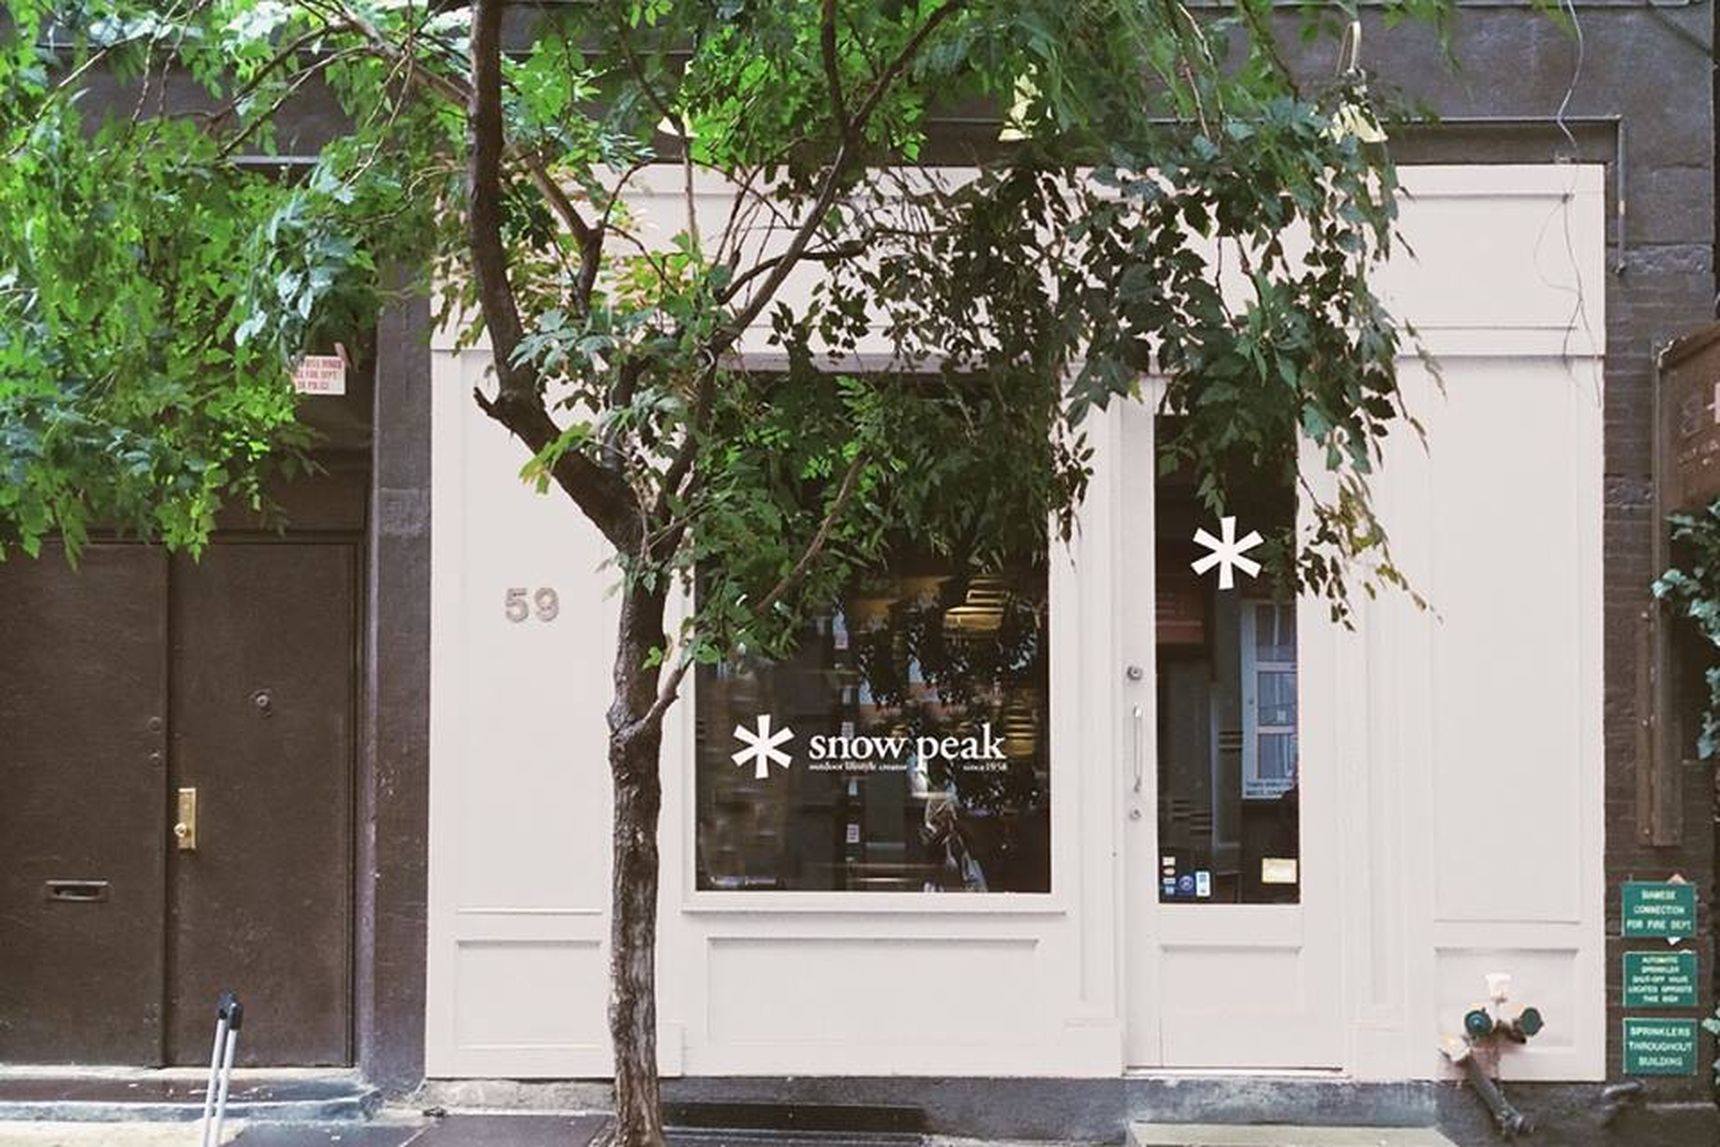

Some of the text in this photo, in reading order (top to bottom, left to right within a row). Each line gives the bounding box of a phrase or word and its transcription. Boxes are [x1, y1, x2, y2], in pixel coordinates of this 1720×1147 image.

[505, 587, 560, 623] 59
[808, 722, 1007, 771] snow peak
[1633, 905, 1685, 915] CONNECTION
[1626, 919, 1644, 929] FOR
[1646, 919, 1666, 930] FIRE
[1630, 1026, 1690, 1037] SPRINKLERS
[1629, 1041, 1692, 1051] THROUGHOUT
[1638, 1056, 1683, 1067] BUILDING
